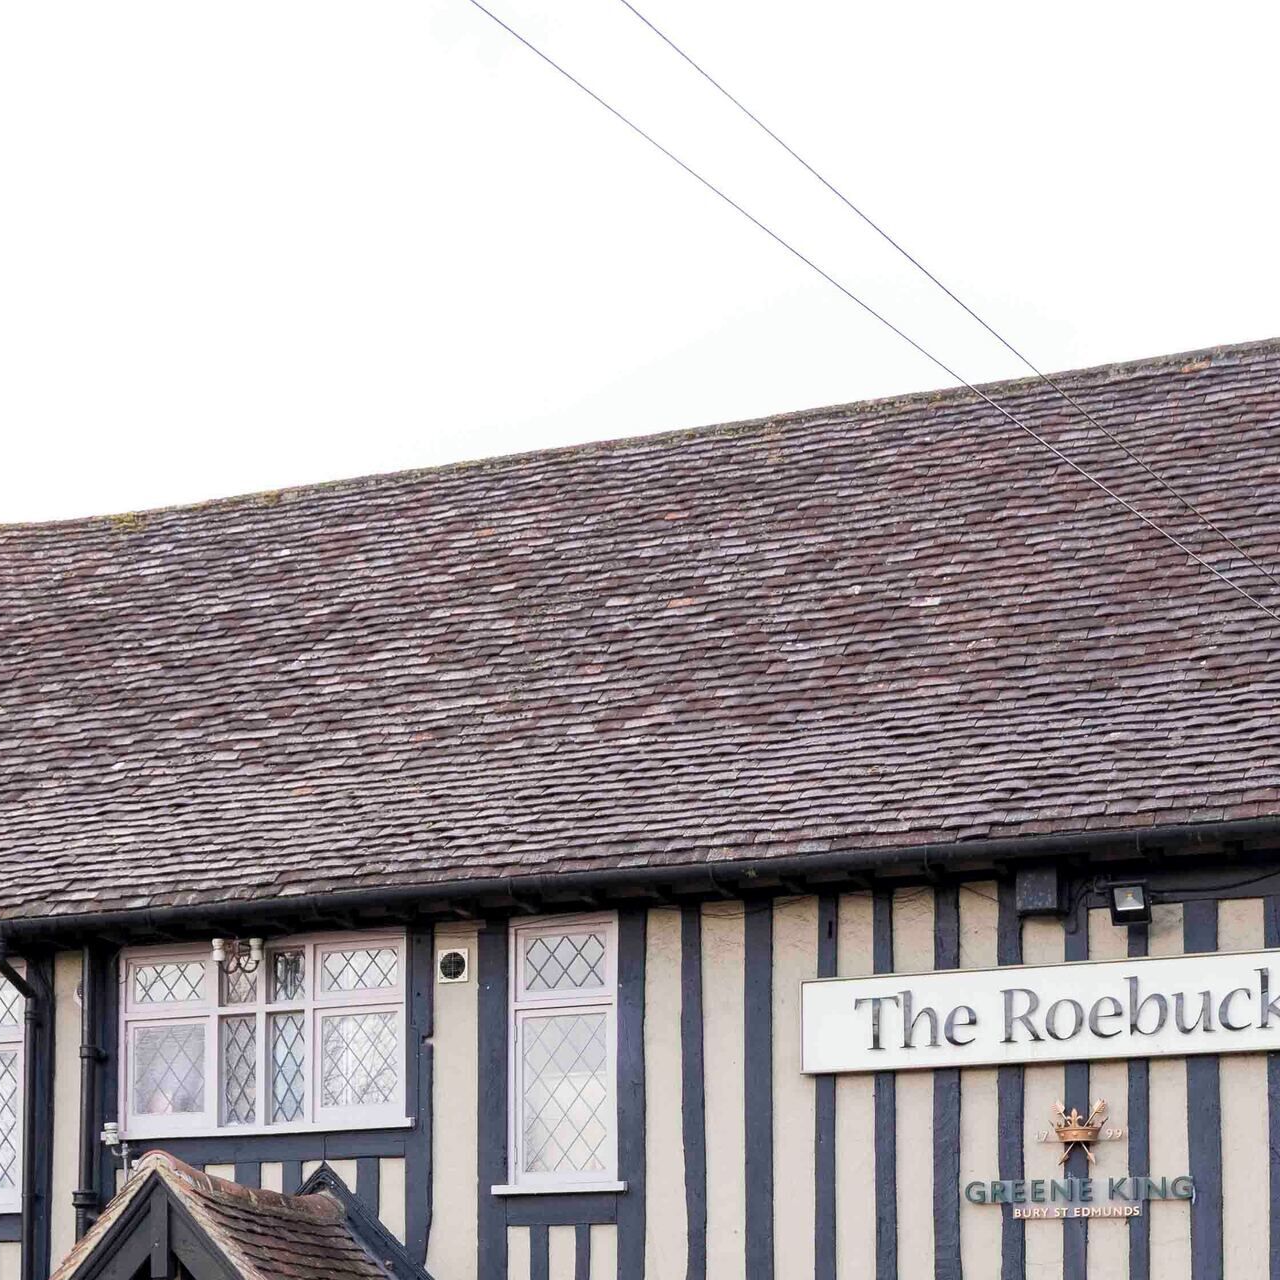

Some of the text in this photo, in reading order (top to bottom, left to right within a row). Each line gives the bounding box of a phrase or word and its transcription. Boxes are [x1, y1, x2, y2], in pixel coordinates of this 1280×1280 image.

[854, 989, 977, 1050] The
[1105, 1128, 1123, 1139] 99
[964, 1175, 1194, 1204] GREENE KING
[1014, 1205, 1140, 1218] BURY ST EDMUNDS
